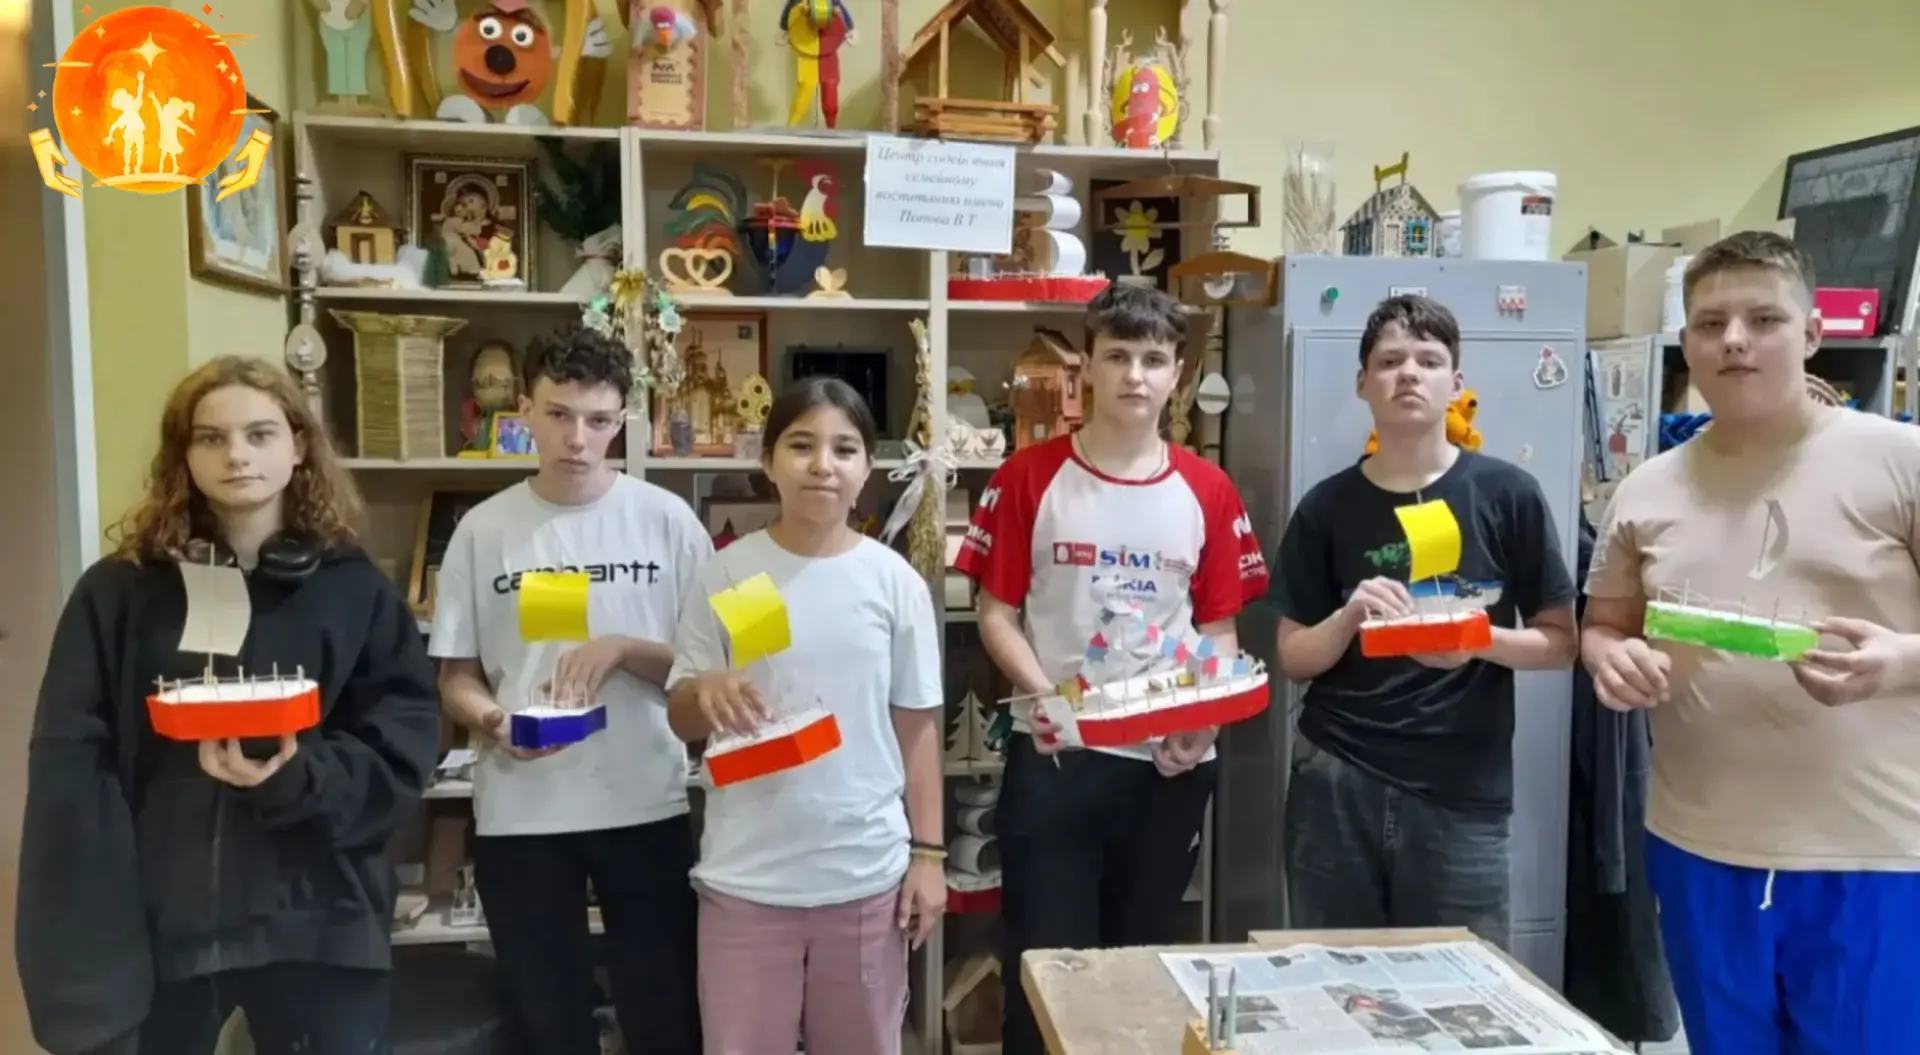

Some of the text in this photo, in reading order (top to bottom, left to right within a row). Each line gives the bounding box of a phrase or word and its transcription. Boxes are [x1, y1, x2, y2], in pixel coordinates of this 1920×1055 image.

[877, 146, 923, 167] Центр
[905, 171, 977, 189] семейному
[875, 190, 1004, 209] воспитанию имени
[900, 209, 950, 227] Попова
